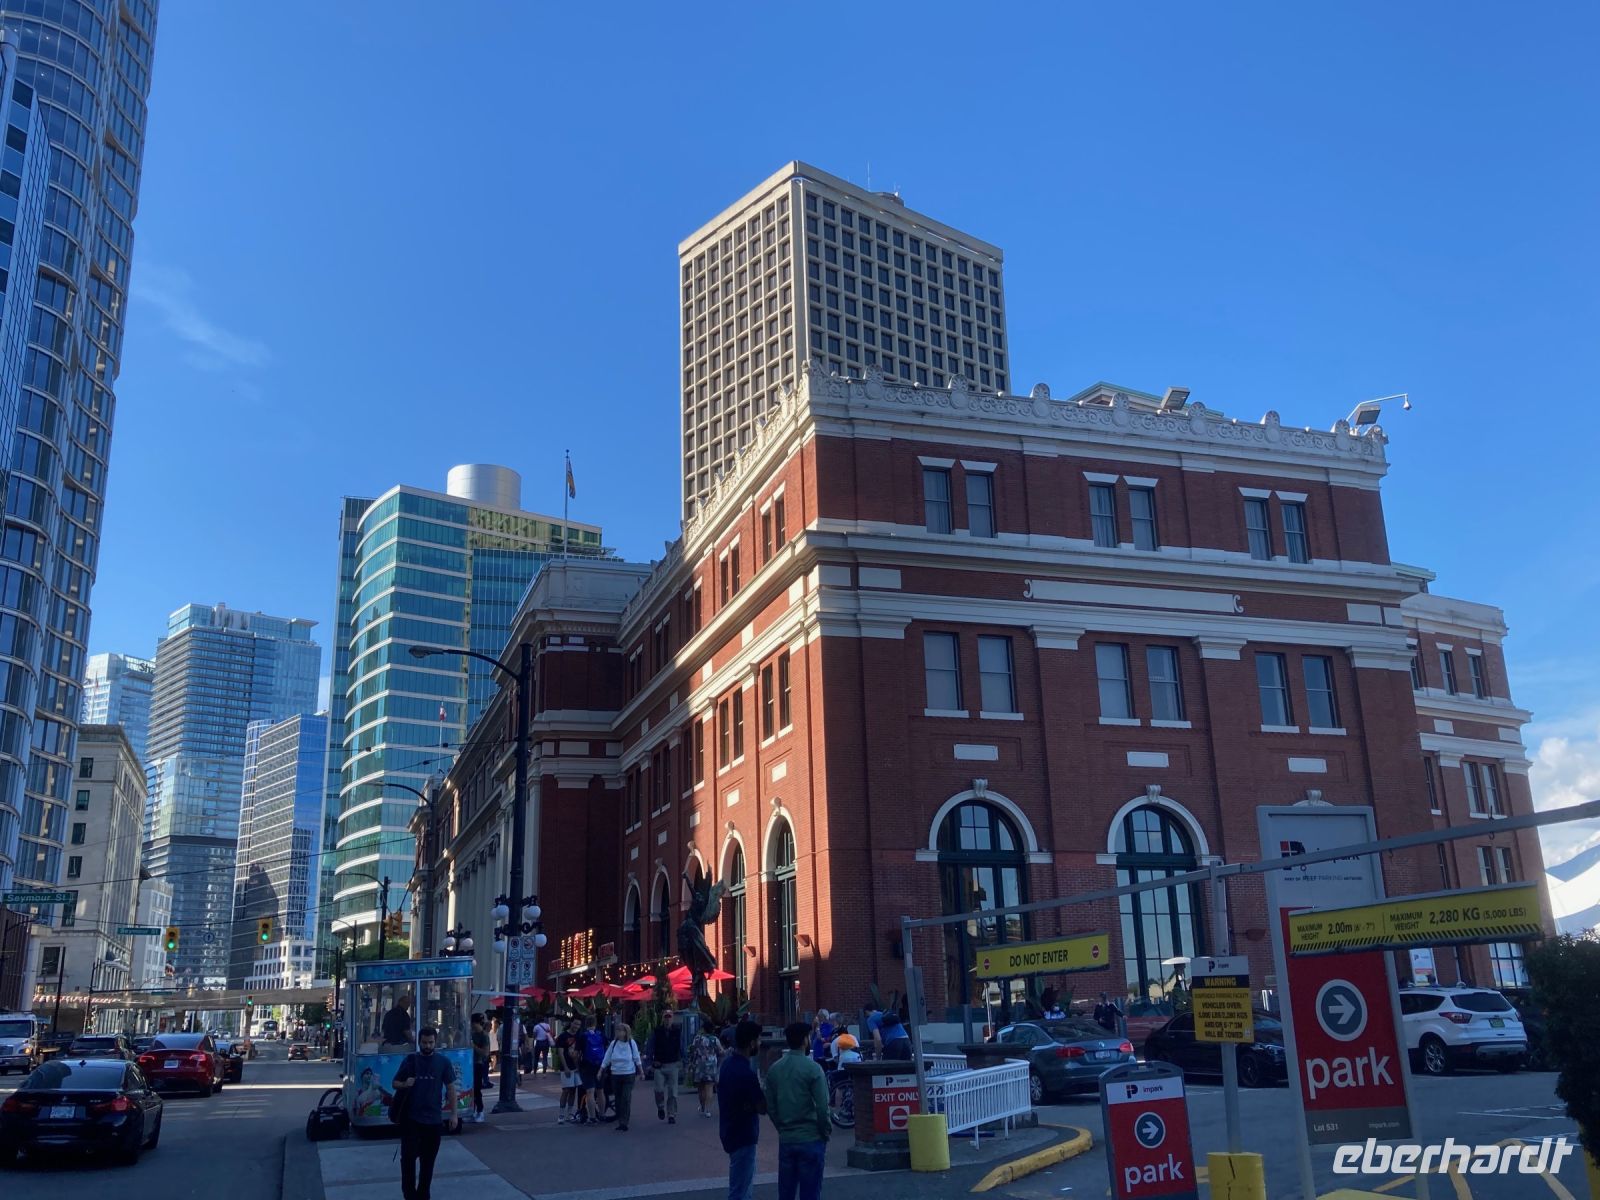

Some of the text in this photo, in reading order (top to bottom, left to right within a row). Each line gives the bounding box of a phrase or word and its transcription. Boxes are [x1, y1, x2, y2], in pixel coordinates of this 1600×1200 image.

[7, 894, 51, 903] Seymour
[55, 893, 66, 902] St
[1390, 911, 1423, 922] MAXIMUM
[1429, 907, 1527, 926] 2,280 KG (5,000 LBS)
[1297, 923, 1323, 933] MAXIMUM
[1328, 921, 1352, 935] 2.00m
[1394, 921, 1420, 931] WEIGHT
[1301, 932, 1319, 941] HEIGHT
[1009, 949, 1068, 967] DO NOT ENTER
[1203, 976, 1237, 987] WARNING
[1305, 1046, 1395, 1100] park
[1143, 1085, 1163, 1094] impark
[874, 1093, 895, 1103] EXIT
[1313, 1123, 1339, 1132] Lot 531
[1124, 1153, 1185, 1193] park
